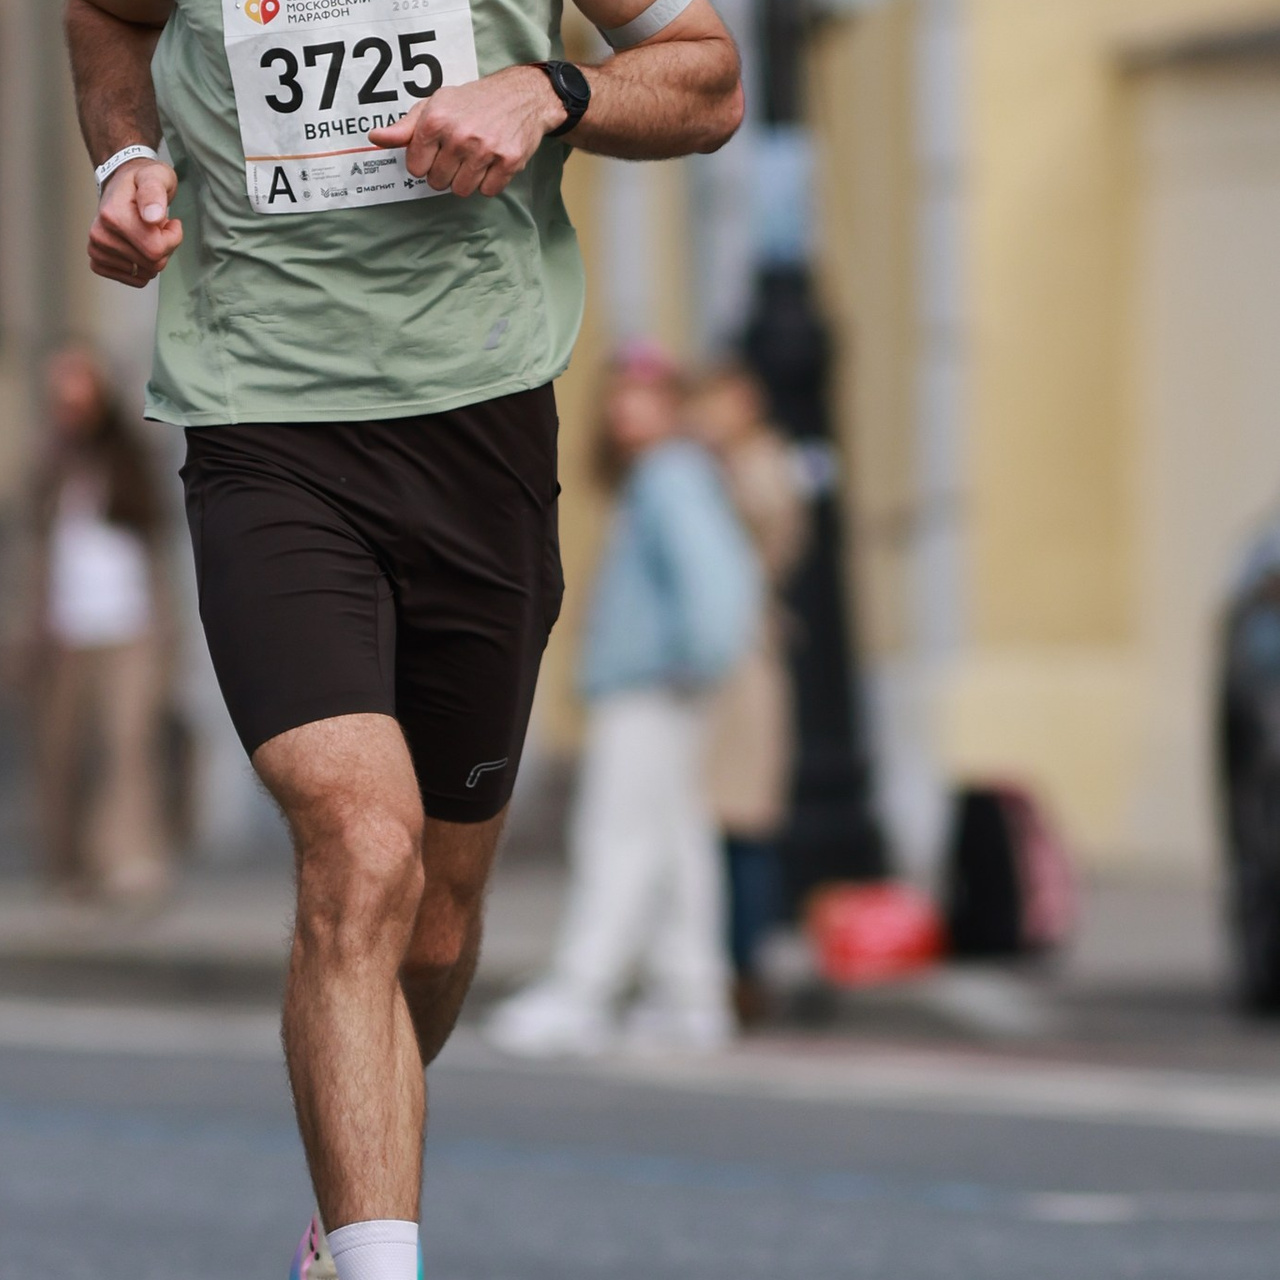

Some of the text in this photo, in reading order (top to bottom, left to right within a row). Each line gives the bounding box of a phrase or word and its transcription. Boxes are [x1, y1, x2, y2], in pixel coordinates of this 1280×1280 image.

[287, 7, 350, 24] МАРАФОН
[260, 30, 443, 114] 3725
[268, 166, 298, 205] A
